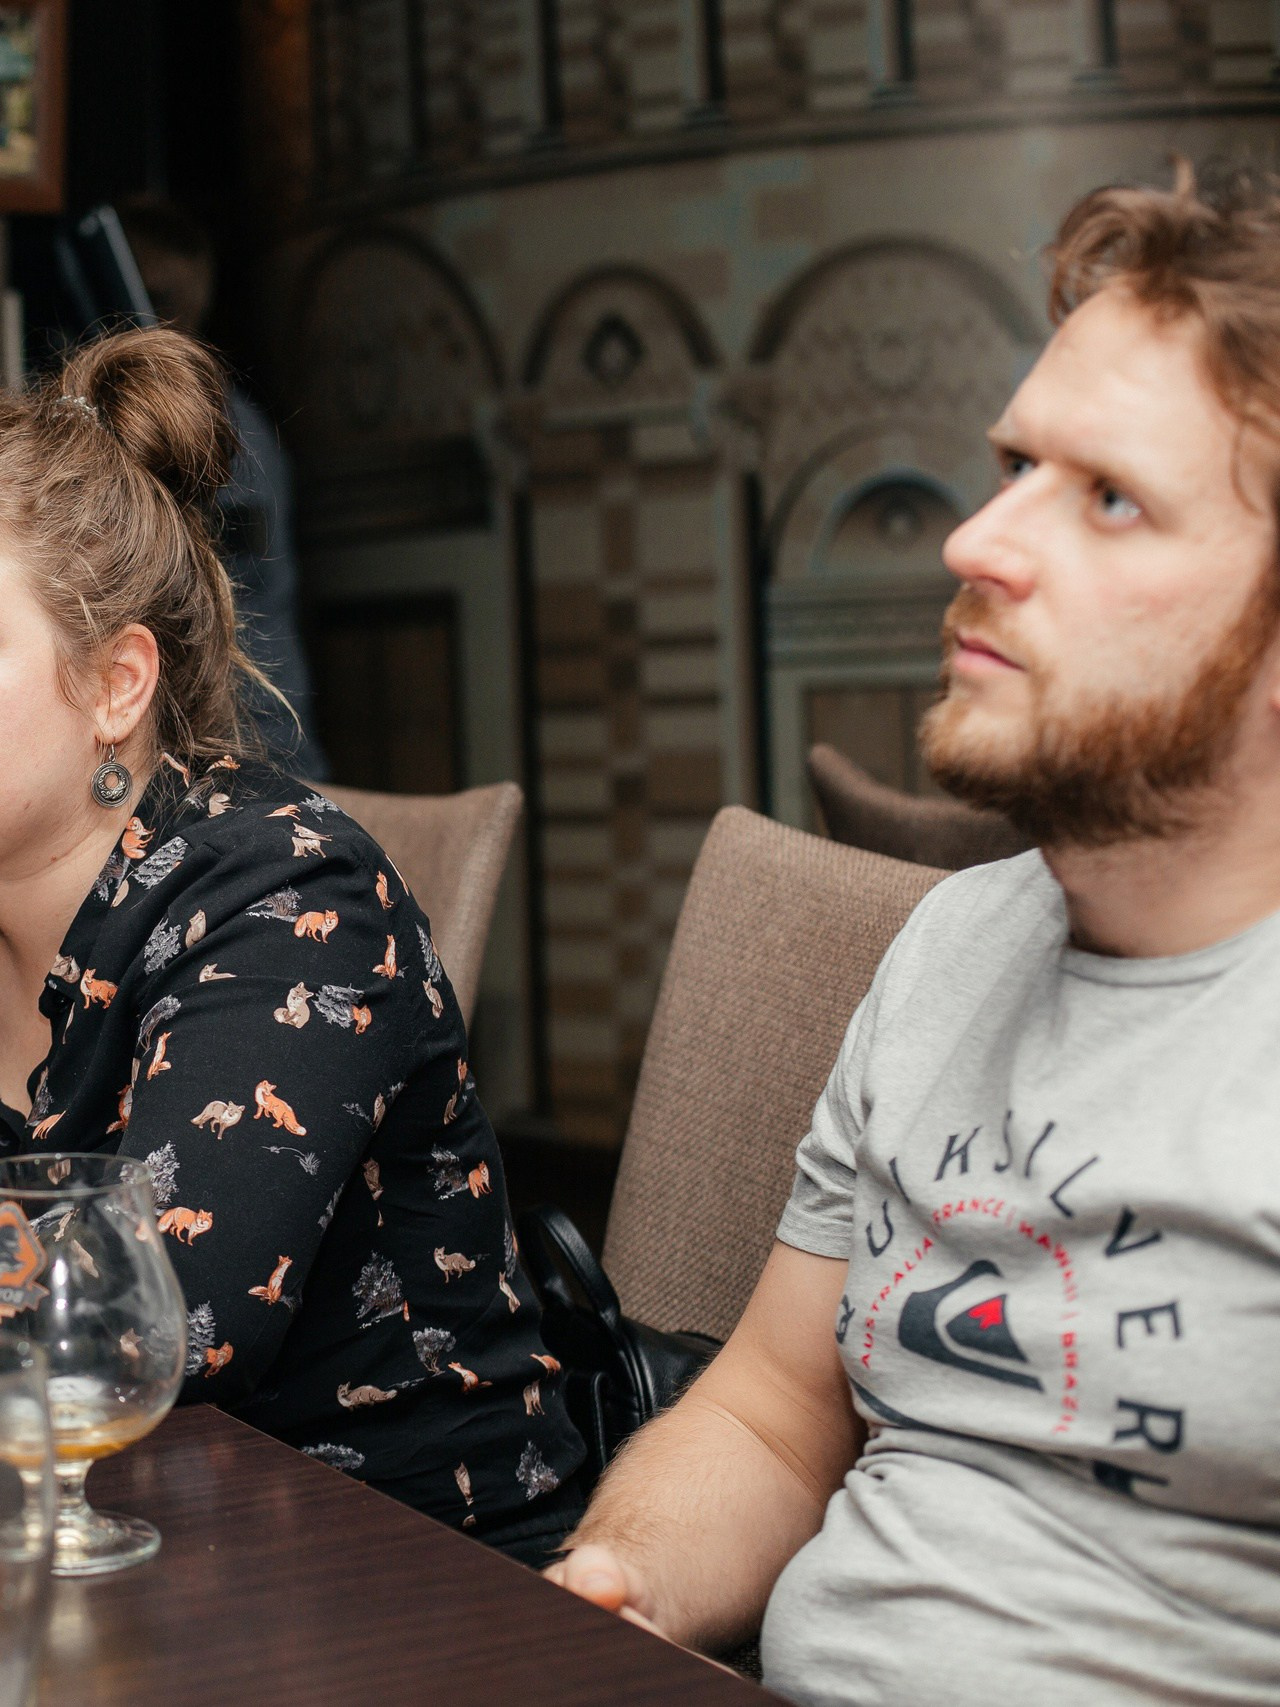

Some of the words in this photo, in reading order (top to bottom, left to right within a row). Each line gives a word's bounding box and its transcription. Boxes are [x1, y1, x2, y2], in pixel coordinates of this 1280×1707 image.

[860, 1236, 934, 1370] AUSTRALIA
[932, 1199, 1005, 1224] FRANCE
[1052, 1331, 1079, 1435] BRAZIL
